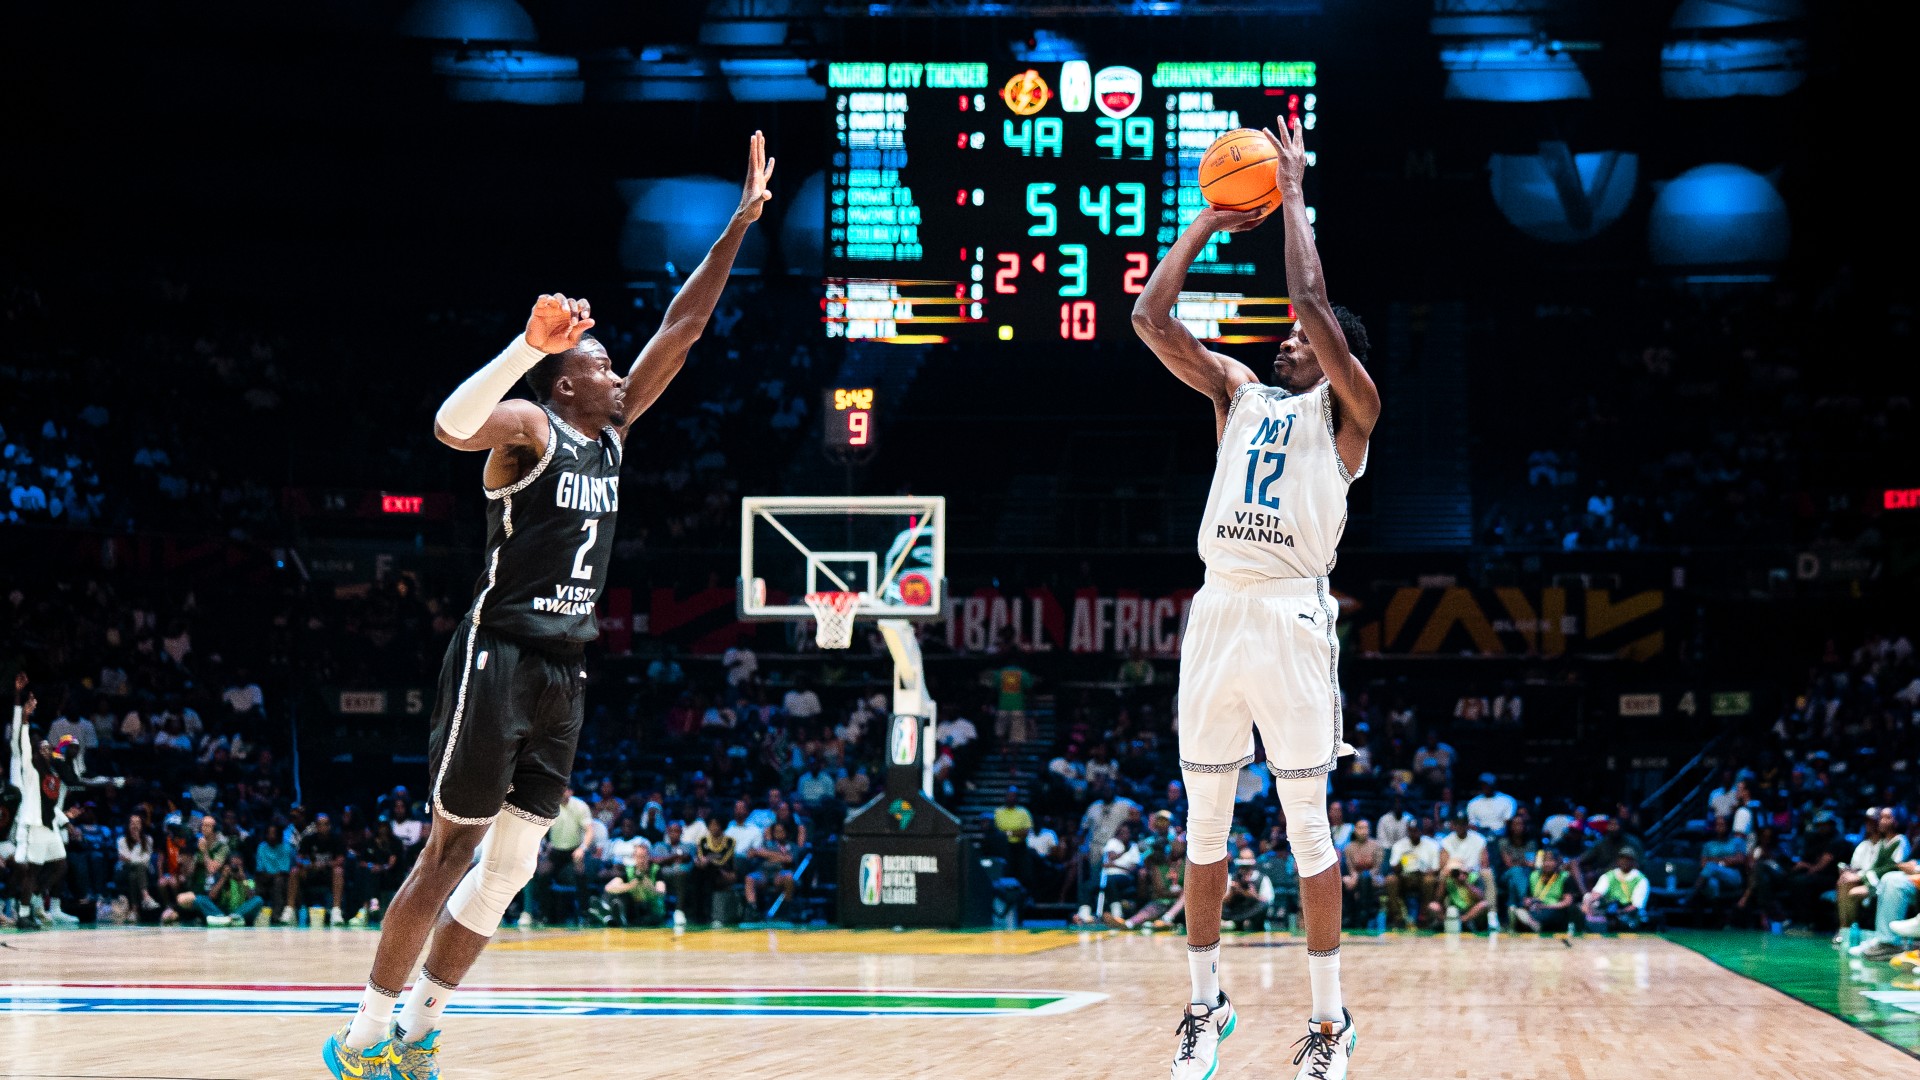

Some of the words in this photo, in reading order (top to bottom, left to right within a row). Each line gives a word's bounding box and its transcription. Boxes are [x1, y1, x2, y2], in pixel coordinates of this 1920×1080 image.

[888, 63, 923, 88] CITY
[1079, 183, 1145, 236] 43
[995, 252, 1020, 294] 2
[1058, 244, 1087, 297] 3
[1124, 252, 1148, 294] 2
[1060, 301, 1096, 340] 10
[849, 412, 868, 445] 9
[556, 471, 619, 512] GIANTS
[1244, 450, 1286, 509] 12
[382, 496, 423, 513] EXIT
[1235, 511, 1280, 529] VISIT
[571, 519, 599, 580] 2
[1217, 525, 1294, 547] RWANDA
[1797, 552, 1820, 580] D
[533, 597, 595, 615] RWAND
[556, 584, 596, 601] VISIT
[944, 597, 1052, 651] TBALL
[406, 690, 423, 714] 5
[1676, 689, 1697, 716] 4
